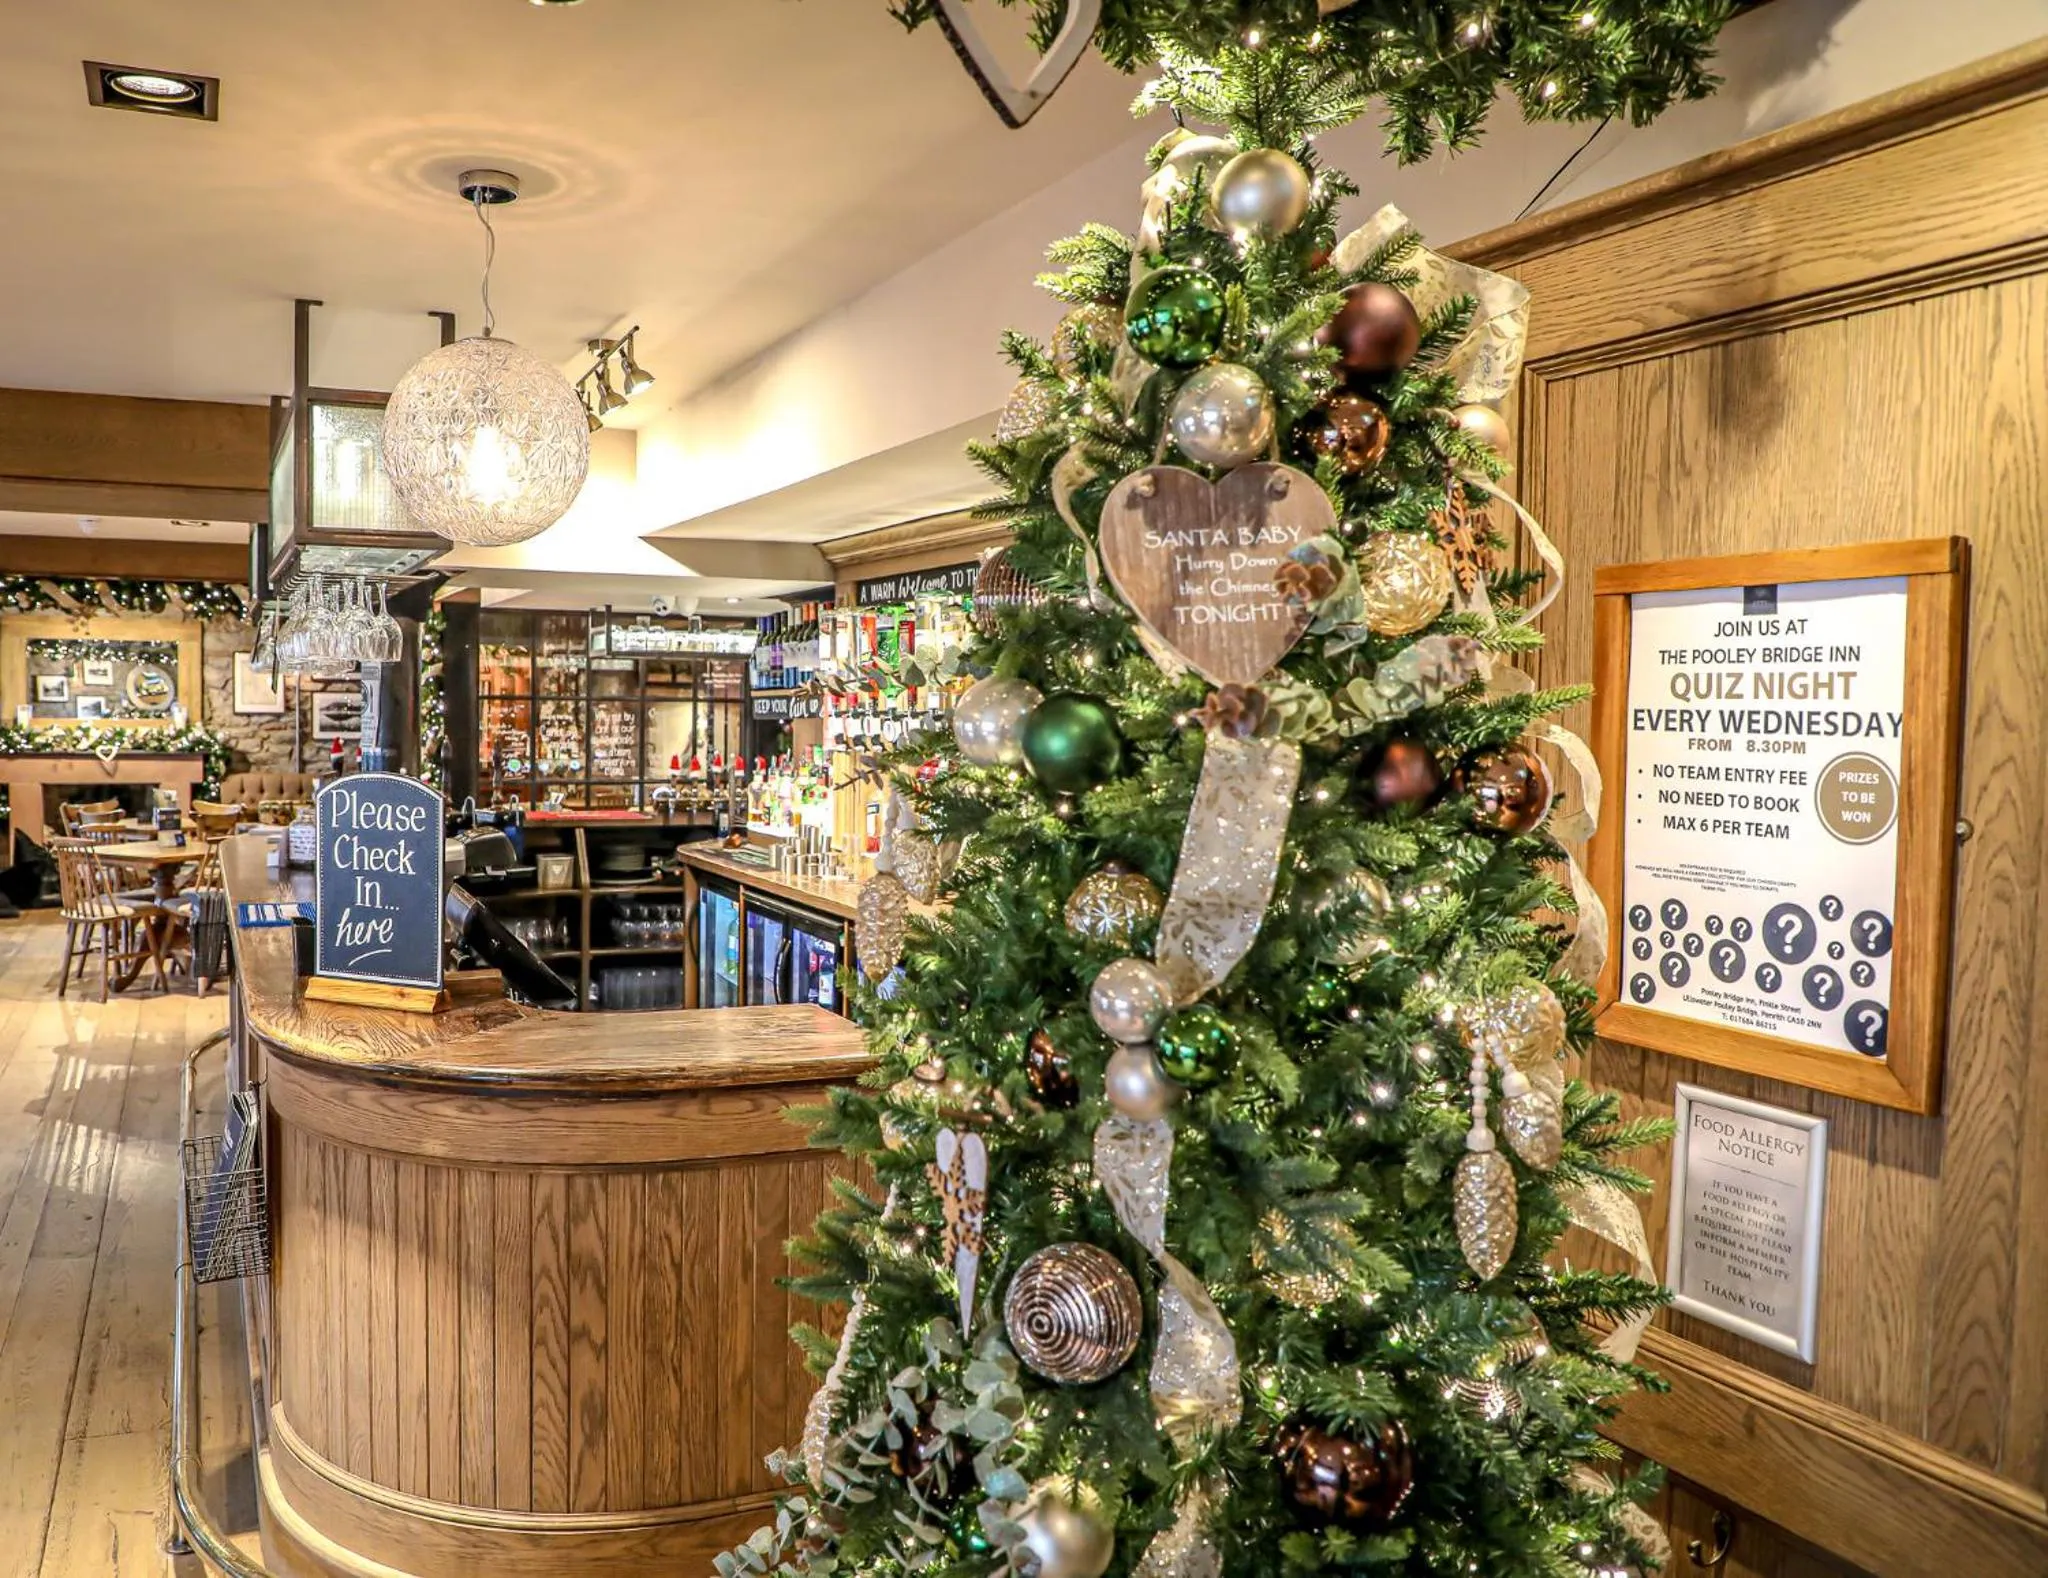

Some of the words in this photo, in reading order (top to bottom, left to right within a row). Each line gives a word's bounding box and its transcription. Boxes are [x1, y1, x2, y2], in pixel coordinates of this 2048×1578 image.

[1143, 528, 1230, 549] SANTA
[1237, 525, 1302, 546] BABY
[1175, 554, 1224, 574] Hurry
[1229, 552, 1278, 571] Down
[860, 584, 867, 603] A
[870, 580, 895, 601] WARM
[898, 574, 948, 599] Welcome
[951, 570, 964, 589] TO
[966, 567, 981, 587] TH
[1179, 580, 1204, 596] the
[1714, 620, 1752, 637] JOIN
[1758, 619, 1780, 636] US
[1785, 618, 1808, 635] AT
[1659, 650, 1687, 665] THE
[1692, 648, 1757, 664] POOLEY
[1762, 646, 1823, 663] BRIDGE
[1829, 646, 1861, 662] INN
[1670, 672, 1744, 703] QUIZ
[1753, 671, 1857, 701] NIGHT
[1633, 708, 1711, 733] EVERY
[1719, 709, 1903, 738] WEDNESDAY
[1688, 738, 1732, 751] FROM
[1746, 739, 1806, 754] 8.30PM
[1653, 763, 1675, 778] NO
[1678, 765, 1720, 781] TEAM
[1724, 767, 1775, 784] ENTRY
[1779, 770, 1807, 786] FEE
[1838, 771, 1880, 785] PRIZES
[1658, 790, 1680, 804] NO
[1684, 791, 1724, 807] NEED
[1728, 793, 1750, 809] TO
[1753, 796, 1800, 813] BOOK
[1841, 791, 1858, 804] TO
[1860, 791, 1876, 804] BE
[331, 789, 426, 832] Please
[1841, 809, 1872, 823] WON
[1663, 815, 1696, 832] MAX
[1700, 818, 1709, 832] 6
[1712, 819, 1742, 836] PER
[1745, 821, 1790, 840] TEAM
[333, 833, 416, 875] Check
[355, 876, 400, 911] In...
[335, 907, 394, 948] here
[1723, 993, 1744, 1003] Bridge
[1694, 1114, 1735, 1137] FOOD
[1739, 1128, 1805, 1157] ALLERGY
[1719, 1138, 1775, 1167] NOTICE
[1704, 1191, 1729, 1205] FOOD
[1732, 1201, 1769, 1219] ALLERGY
[1724, 1184, 1743, 1196] YOU
[1746, 1191, 1769, 1204] HAVE
[1748, 1219, 1786, 1237] DIETARY
[1700, 1229, 1736, 1248] INFORM
[1747, 1246, 1785, 1265] MEMBER
[1695, 1241, 1706, 1250] OF
[1710, 1246, 1726, 1258] THE
[1730, 1253, 1789, 1280] HOSPITALITY
[1728, 1265, 1751, 1281] TEAM
[1704, 1279, 1746, 1309] THANK
[1749, 1299, 1776, 1317] YOU
